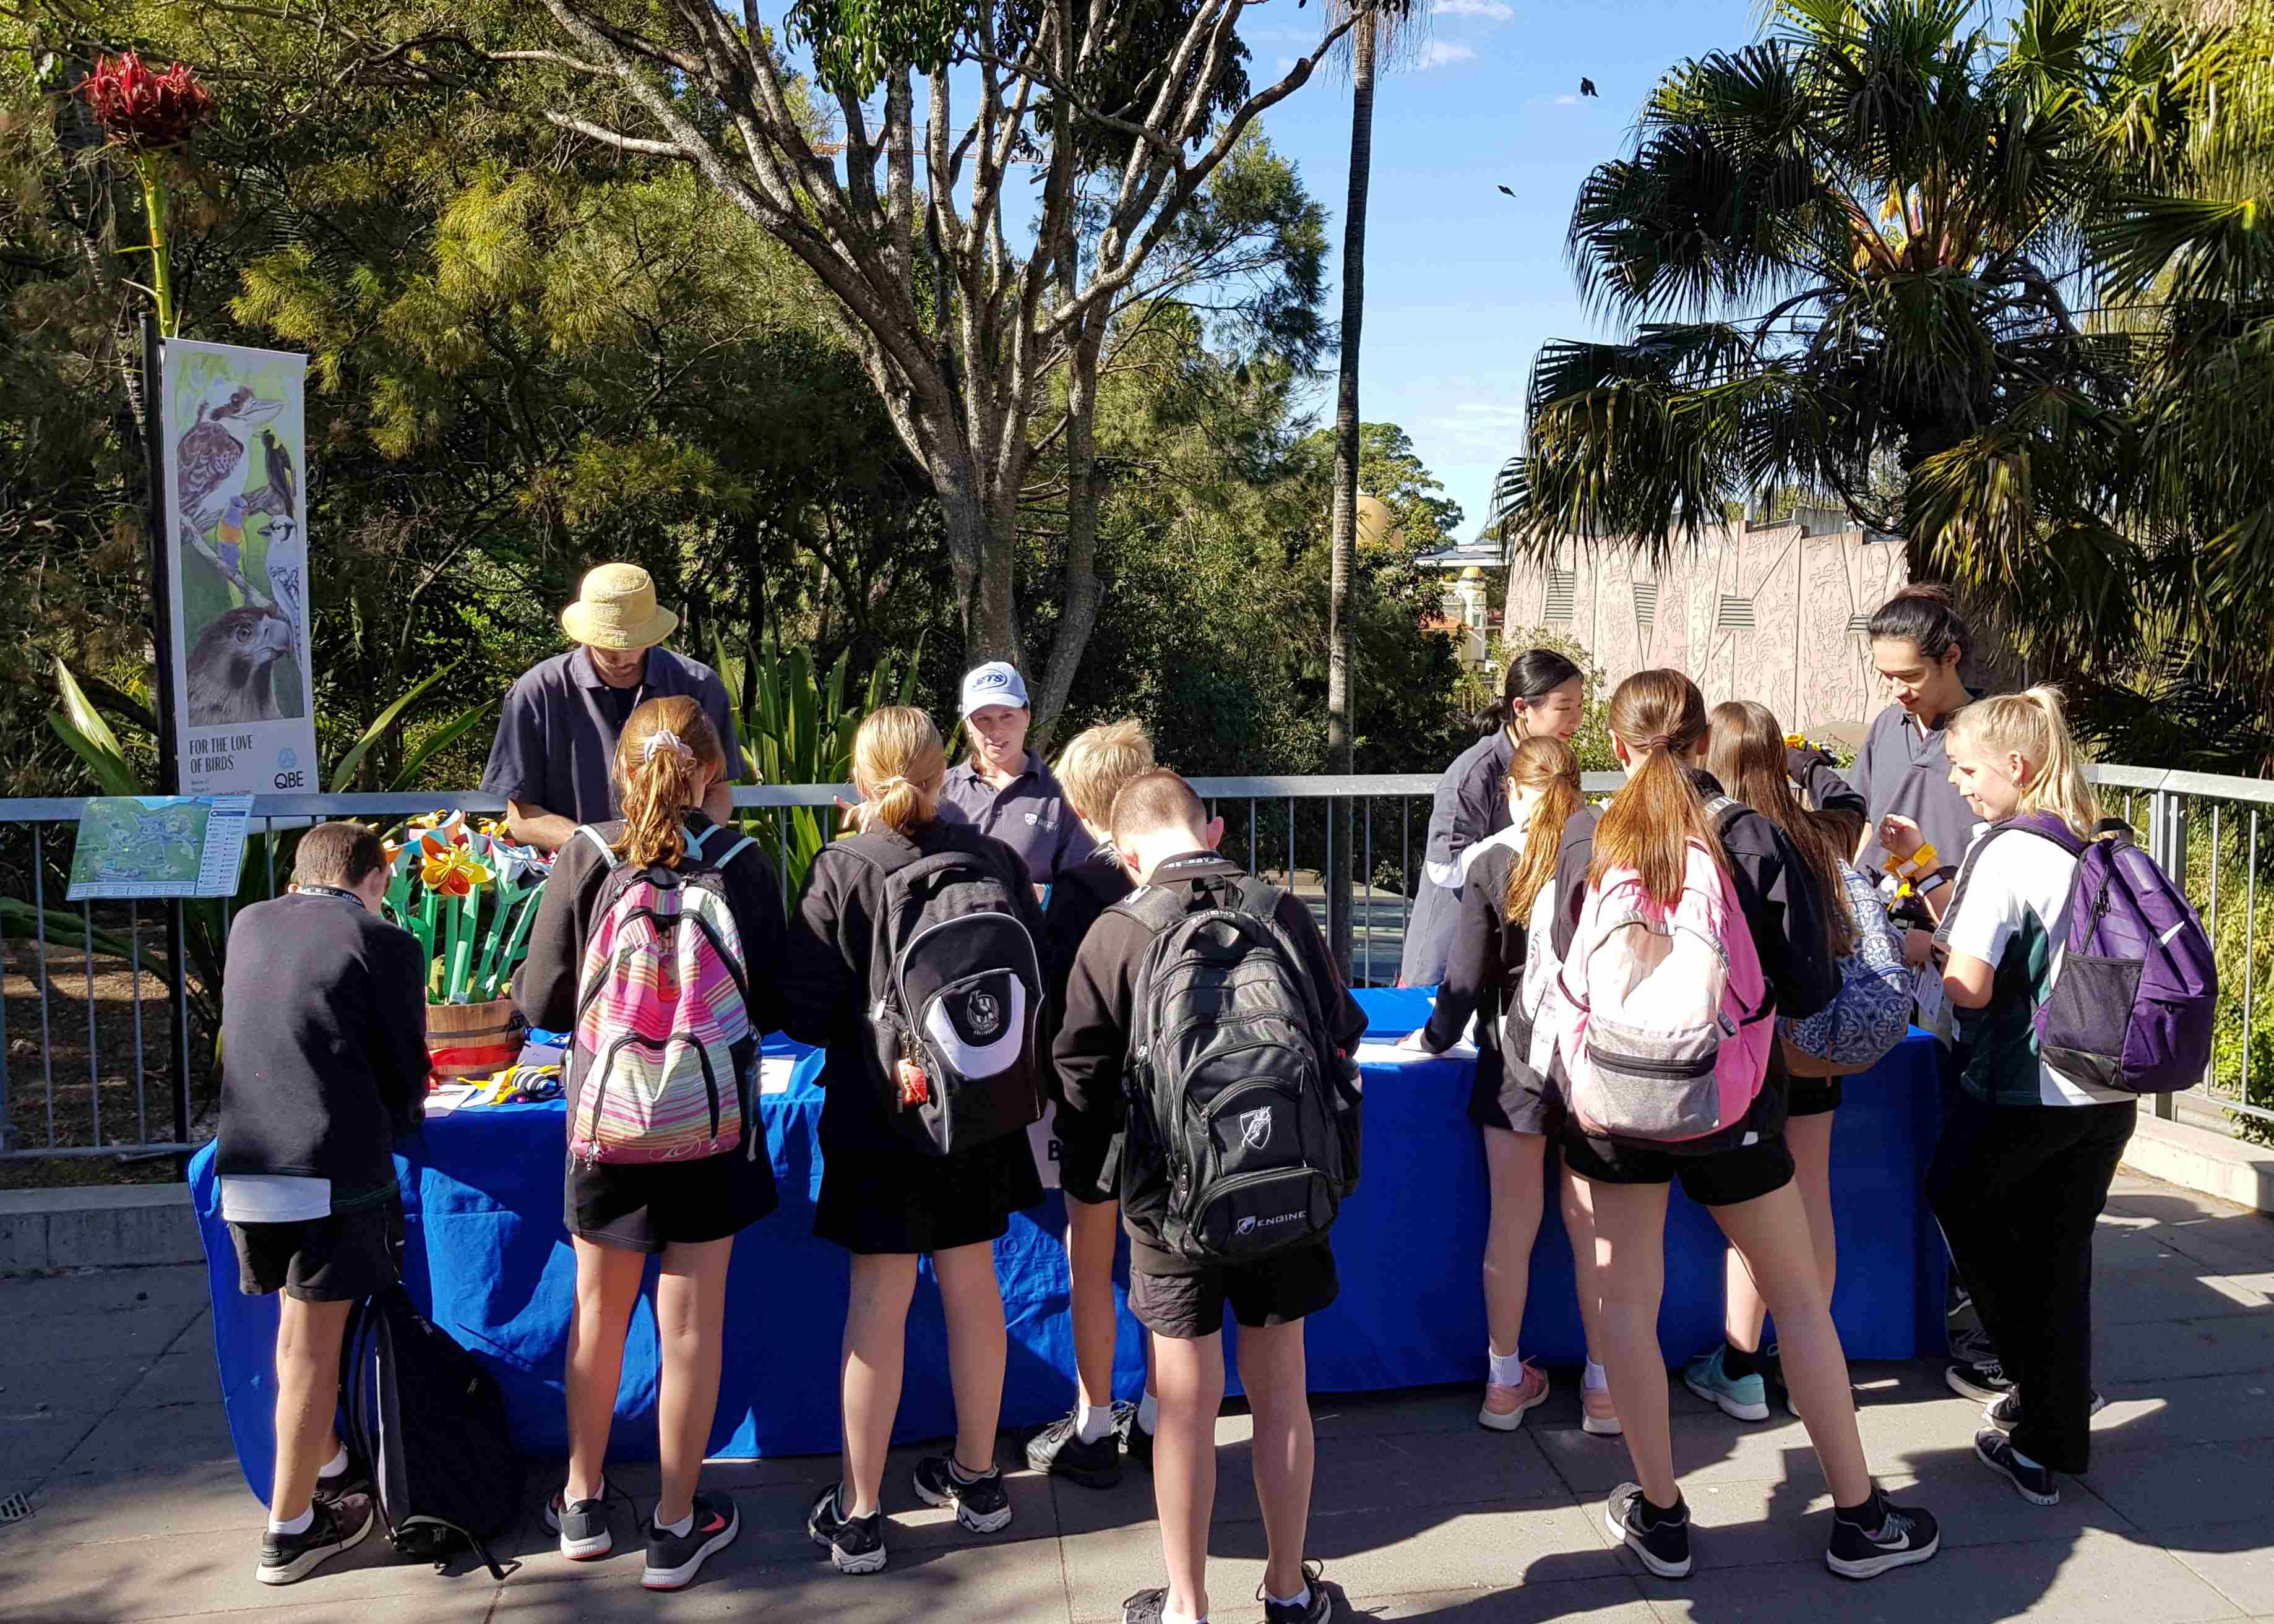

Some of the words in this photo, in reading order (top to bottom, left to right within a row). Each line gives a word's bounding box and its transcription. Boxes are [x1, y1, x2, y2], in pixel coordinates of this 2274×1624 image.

[189, 739, 208, 755] FOR
[211, 737, 228, 752] THE
[231, 734, 253, 750] LOVE
[191, 758, 203, 773] OF
[205, 755, 233, 772] BIRDS
[274, 771, 304, 789] QBE
[1257, 1210, 1307, 1226] ENGINE
